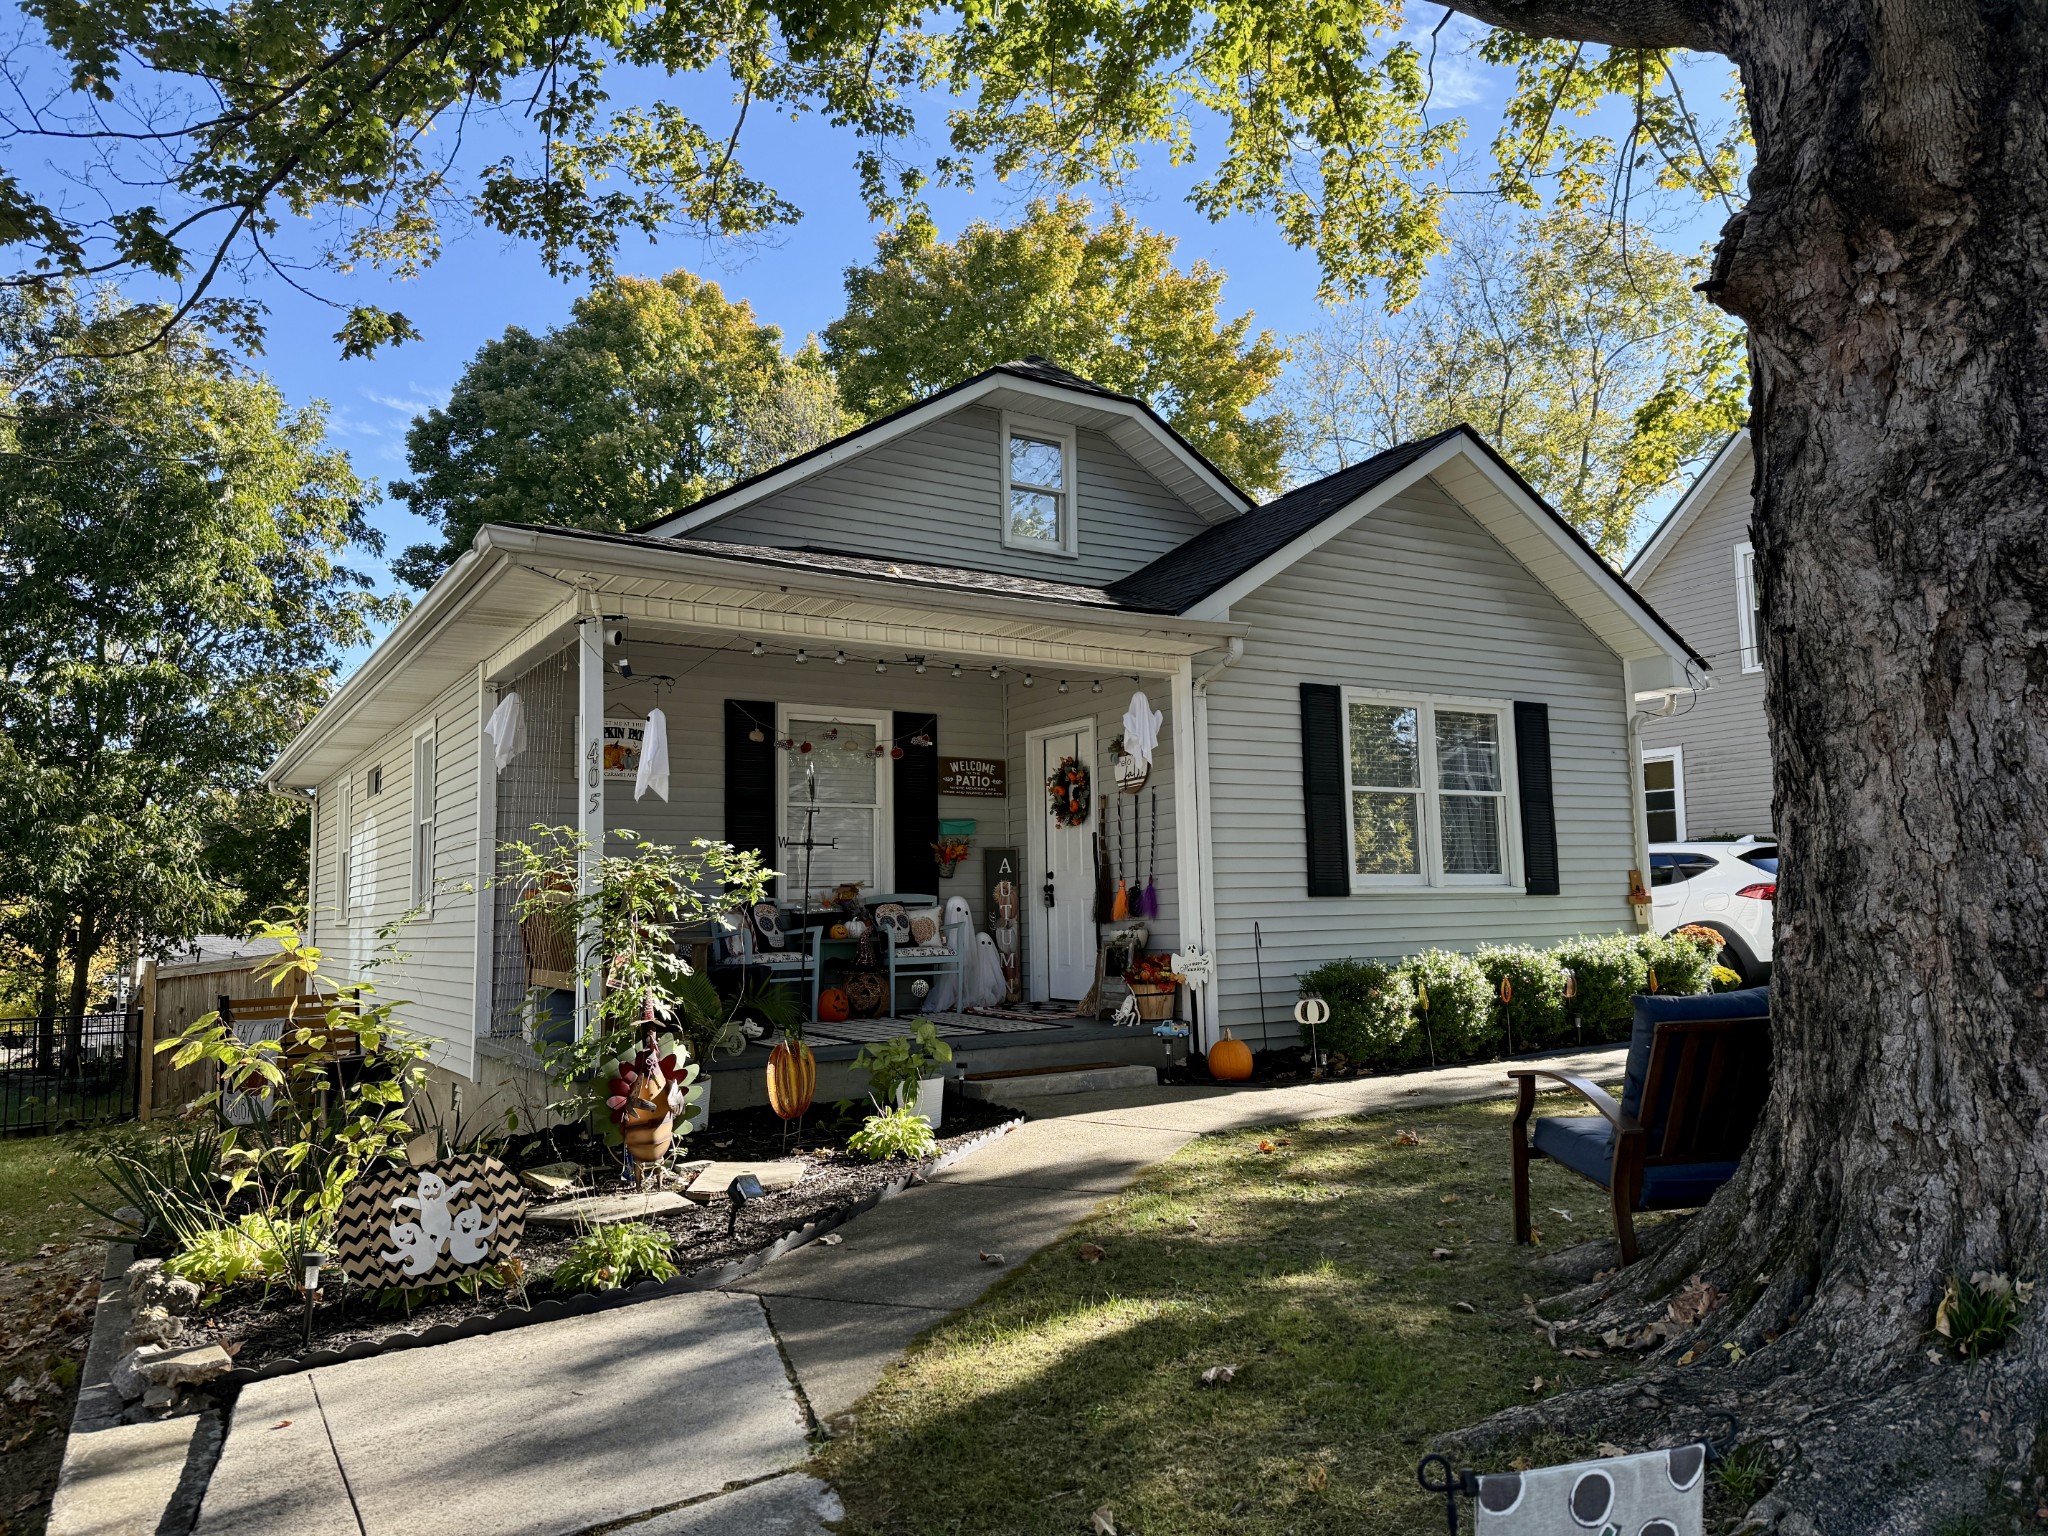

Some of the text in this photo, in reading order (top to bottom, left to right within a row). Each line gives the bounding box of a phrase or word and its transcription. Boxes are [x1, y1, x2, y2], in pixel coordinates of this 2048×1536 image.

[604, 727, 644, 741] PKIN PAT
[950, 760, 996, 775] WELCOME
[587, 741, 602, 815] 405
[956, 775, 990, 787] PATIO
[777, 836, 840, 850] W E
[998, 857, 1016, 995] AUTUMN
